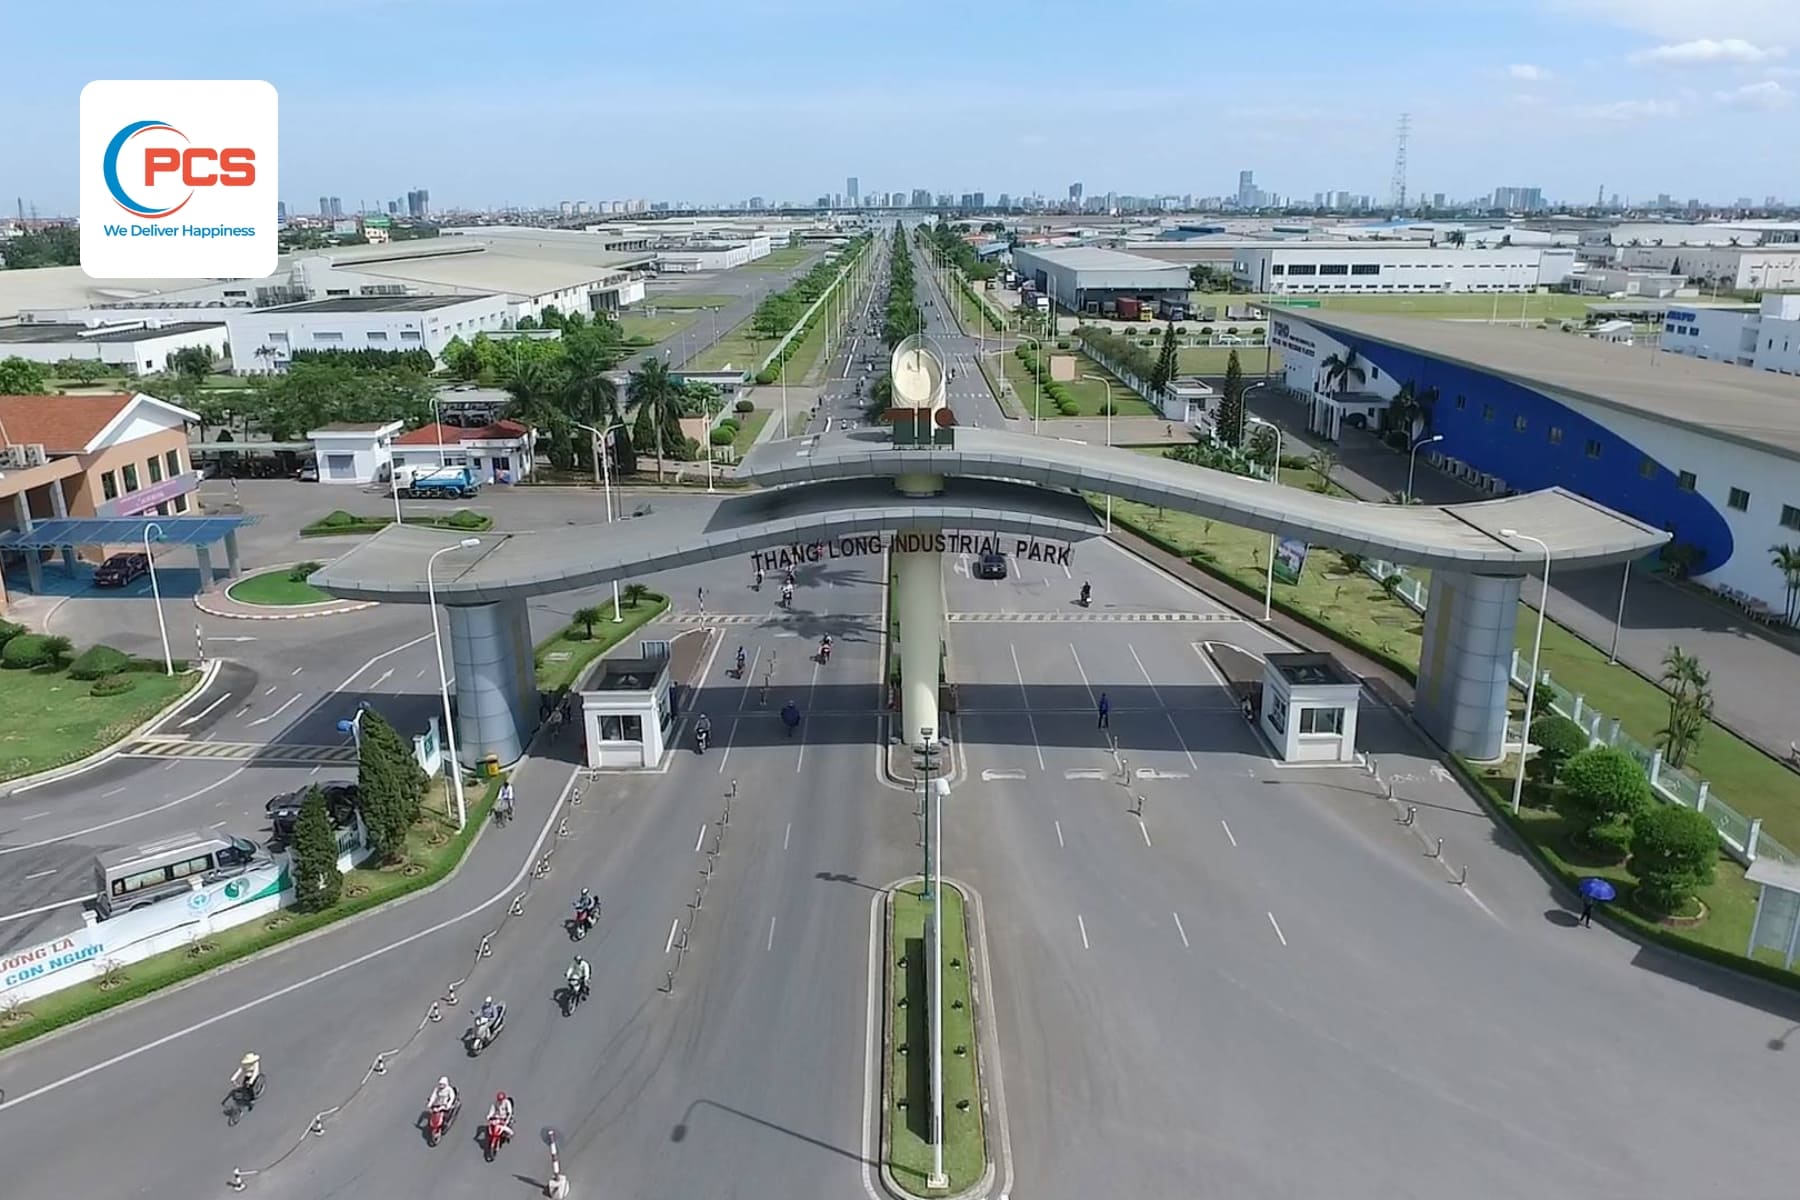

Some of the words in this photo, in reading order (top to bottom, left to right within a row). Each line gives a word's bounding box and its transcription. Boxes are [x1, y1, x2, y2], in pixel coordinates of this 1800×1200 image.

[751, 543, 820, 571] THANG
[828, 535, 882, 559] LONG
[890, 534, 1006, 556] INDUSTRIAL
[1016, 540, 1071, 567] PARK
[5, 964, 44, 986] CON
